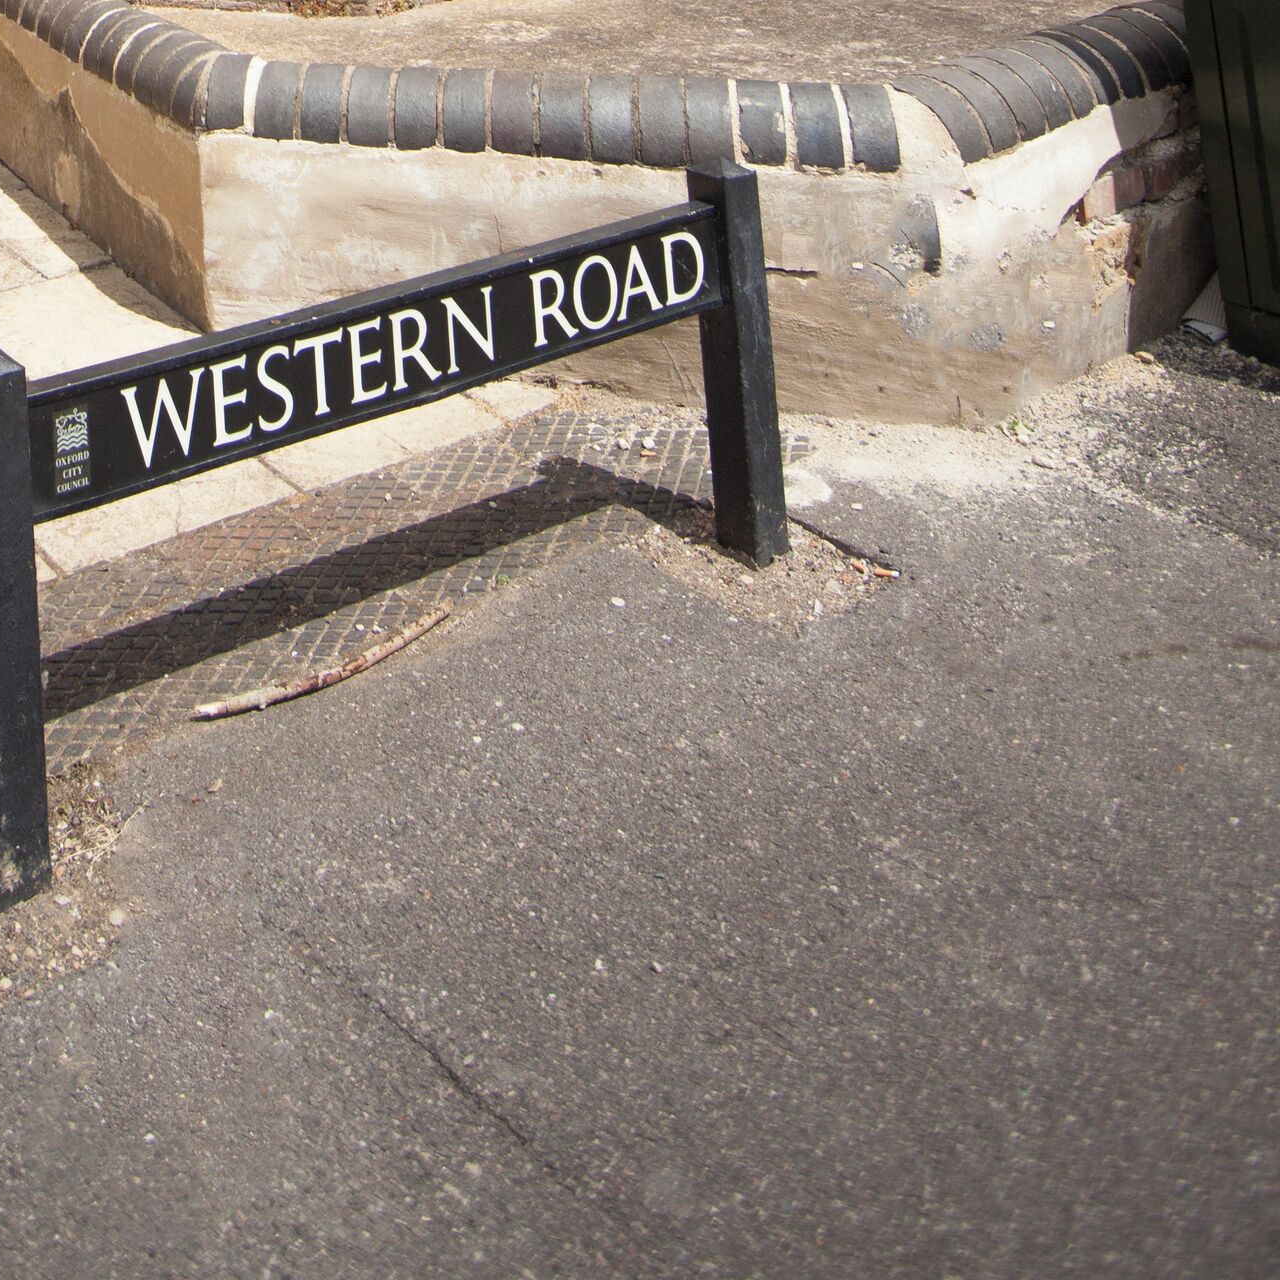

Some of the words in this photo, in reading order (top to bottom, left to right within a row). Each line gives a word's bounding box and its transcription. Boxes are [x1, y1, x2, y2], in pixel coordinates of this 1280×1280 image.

[120, 285, 496, 469] WESTERN
[529, 231, 706, 348] ROAD
[55, 449, 90, 468] OXFORD
[62, 465, 84, 479] CITY
[56, 476, 91, 494] COUNCIL
